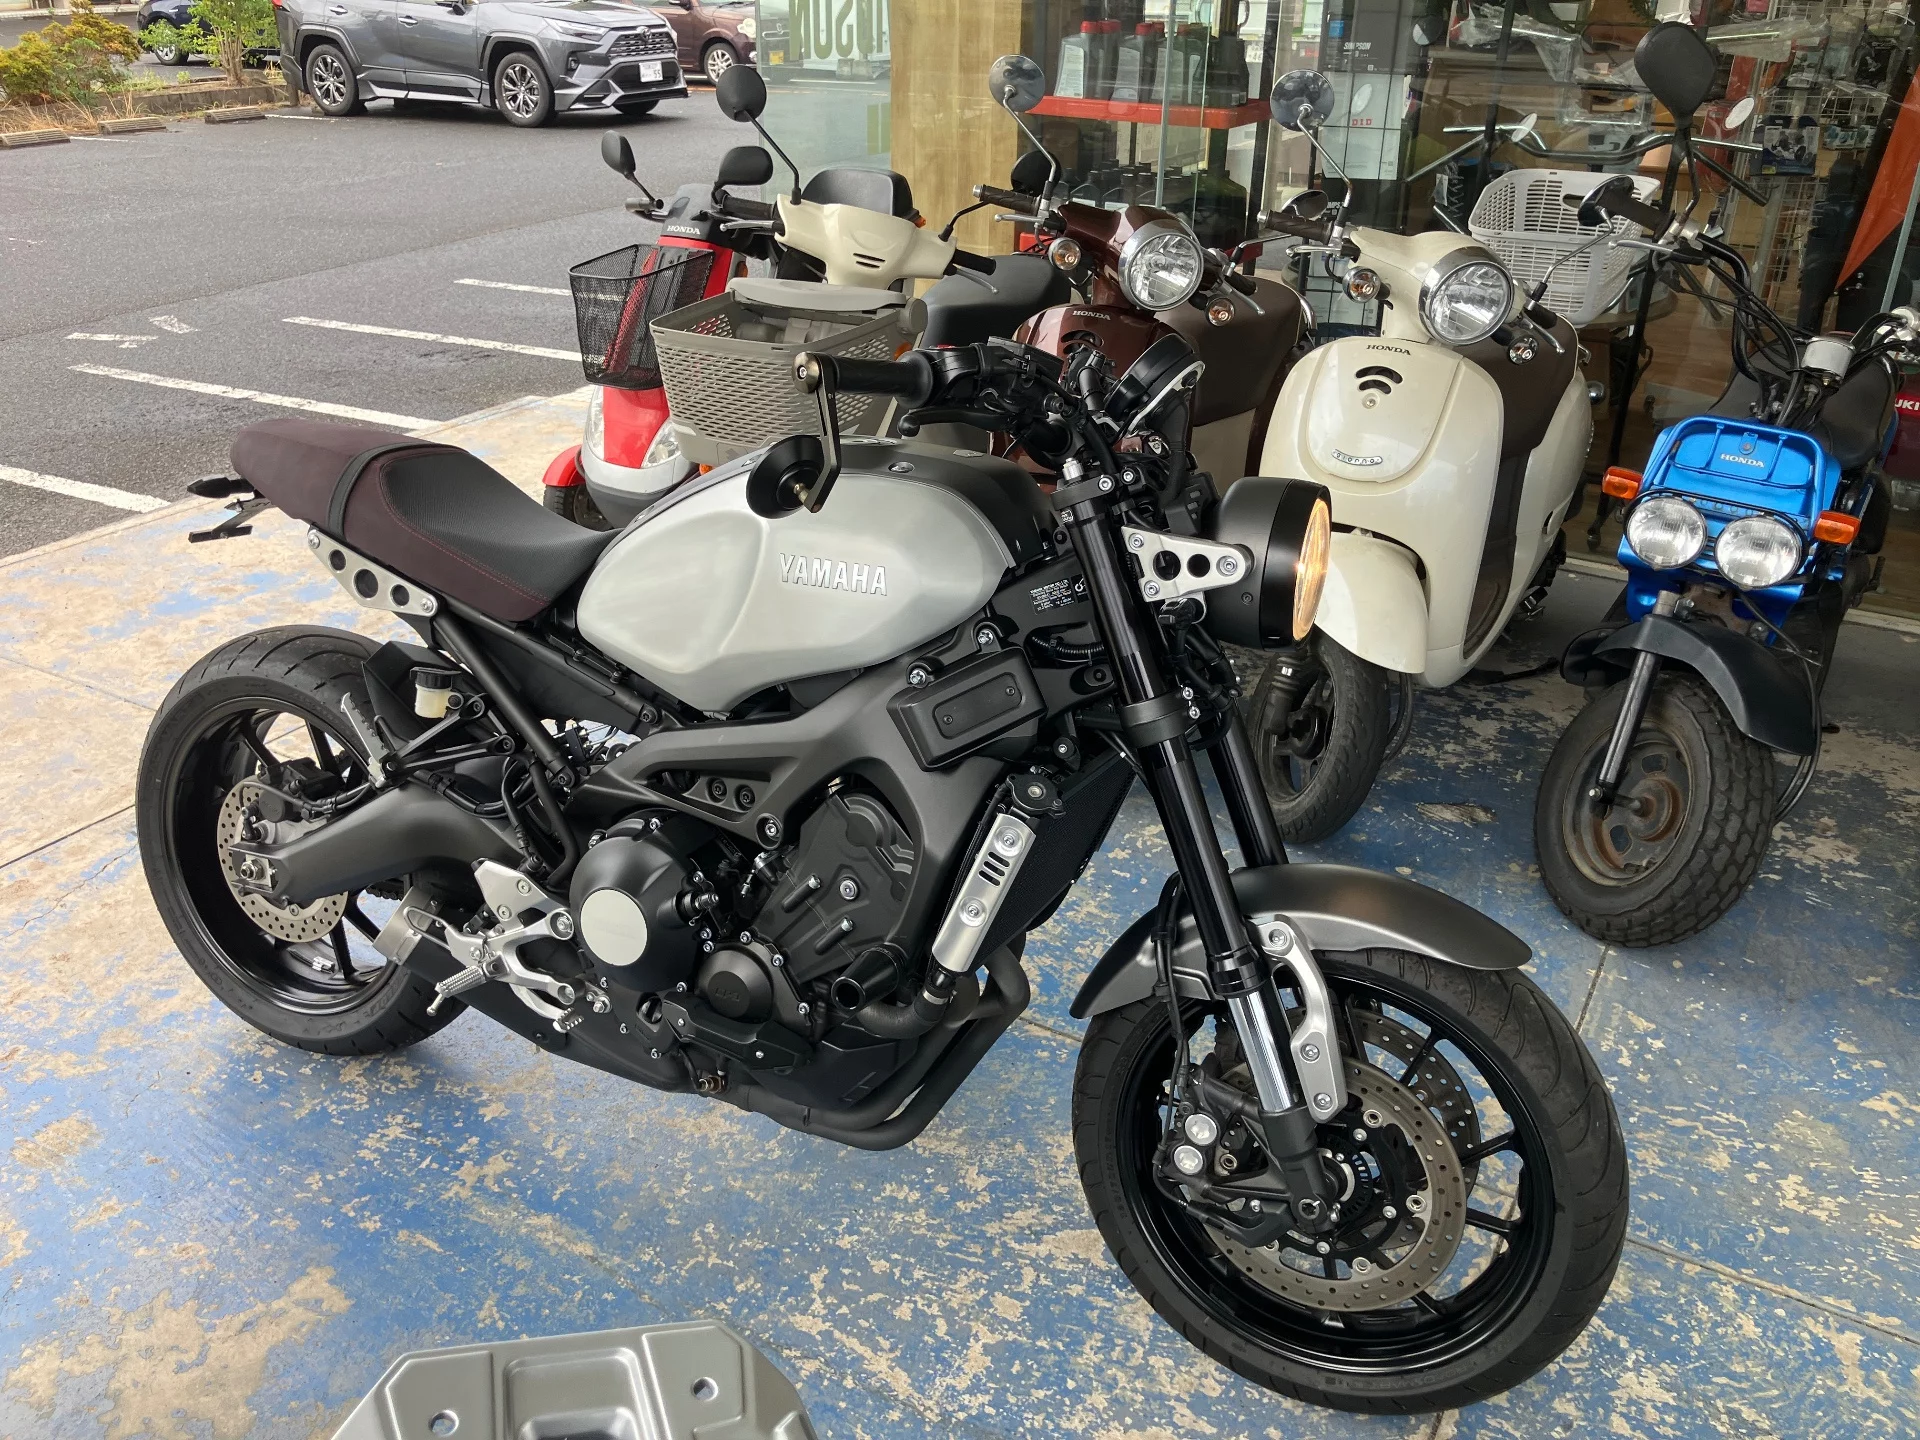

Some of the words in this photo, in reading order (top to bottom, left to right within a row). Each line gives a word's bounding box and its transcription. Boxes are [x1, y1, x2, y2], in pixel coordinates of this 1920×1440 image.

[1343, 42, 1371, 50] SIMPSON
[666, 225, 701, 235] HONDA
[1071, 309, 1112, 321] HONDA
[1366, 344, 1411, 356] HONDA
[1720, 453, 1765, 468] HONDA
[779, 552, 888, 597] YAMAHA
